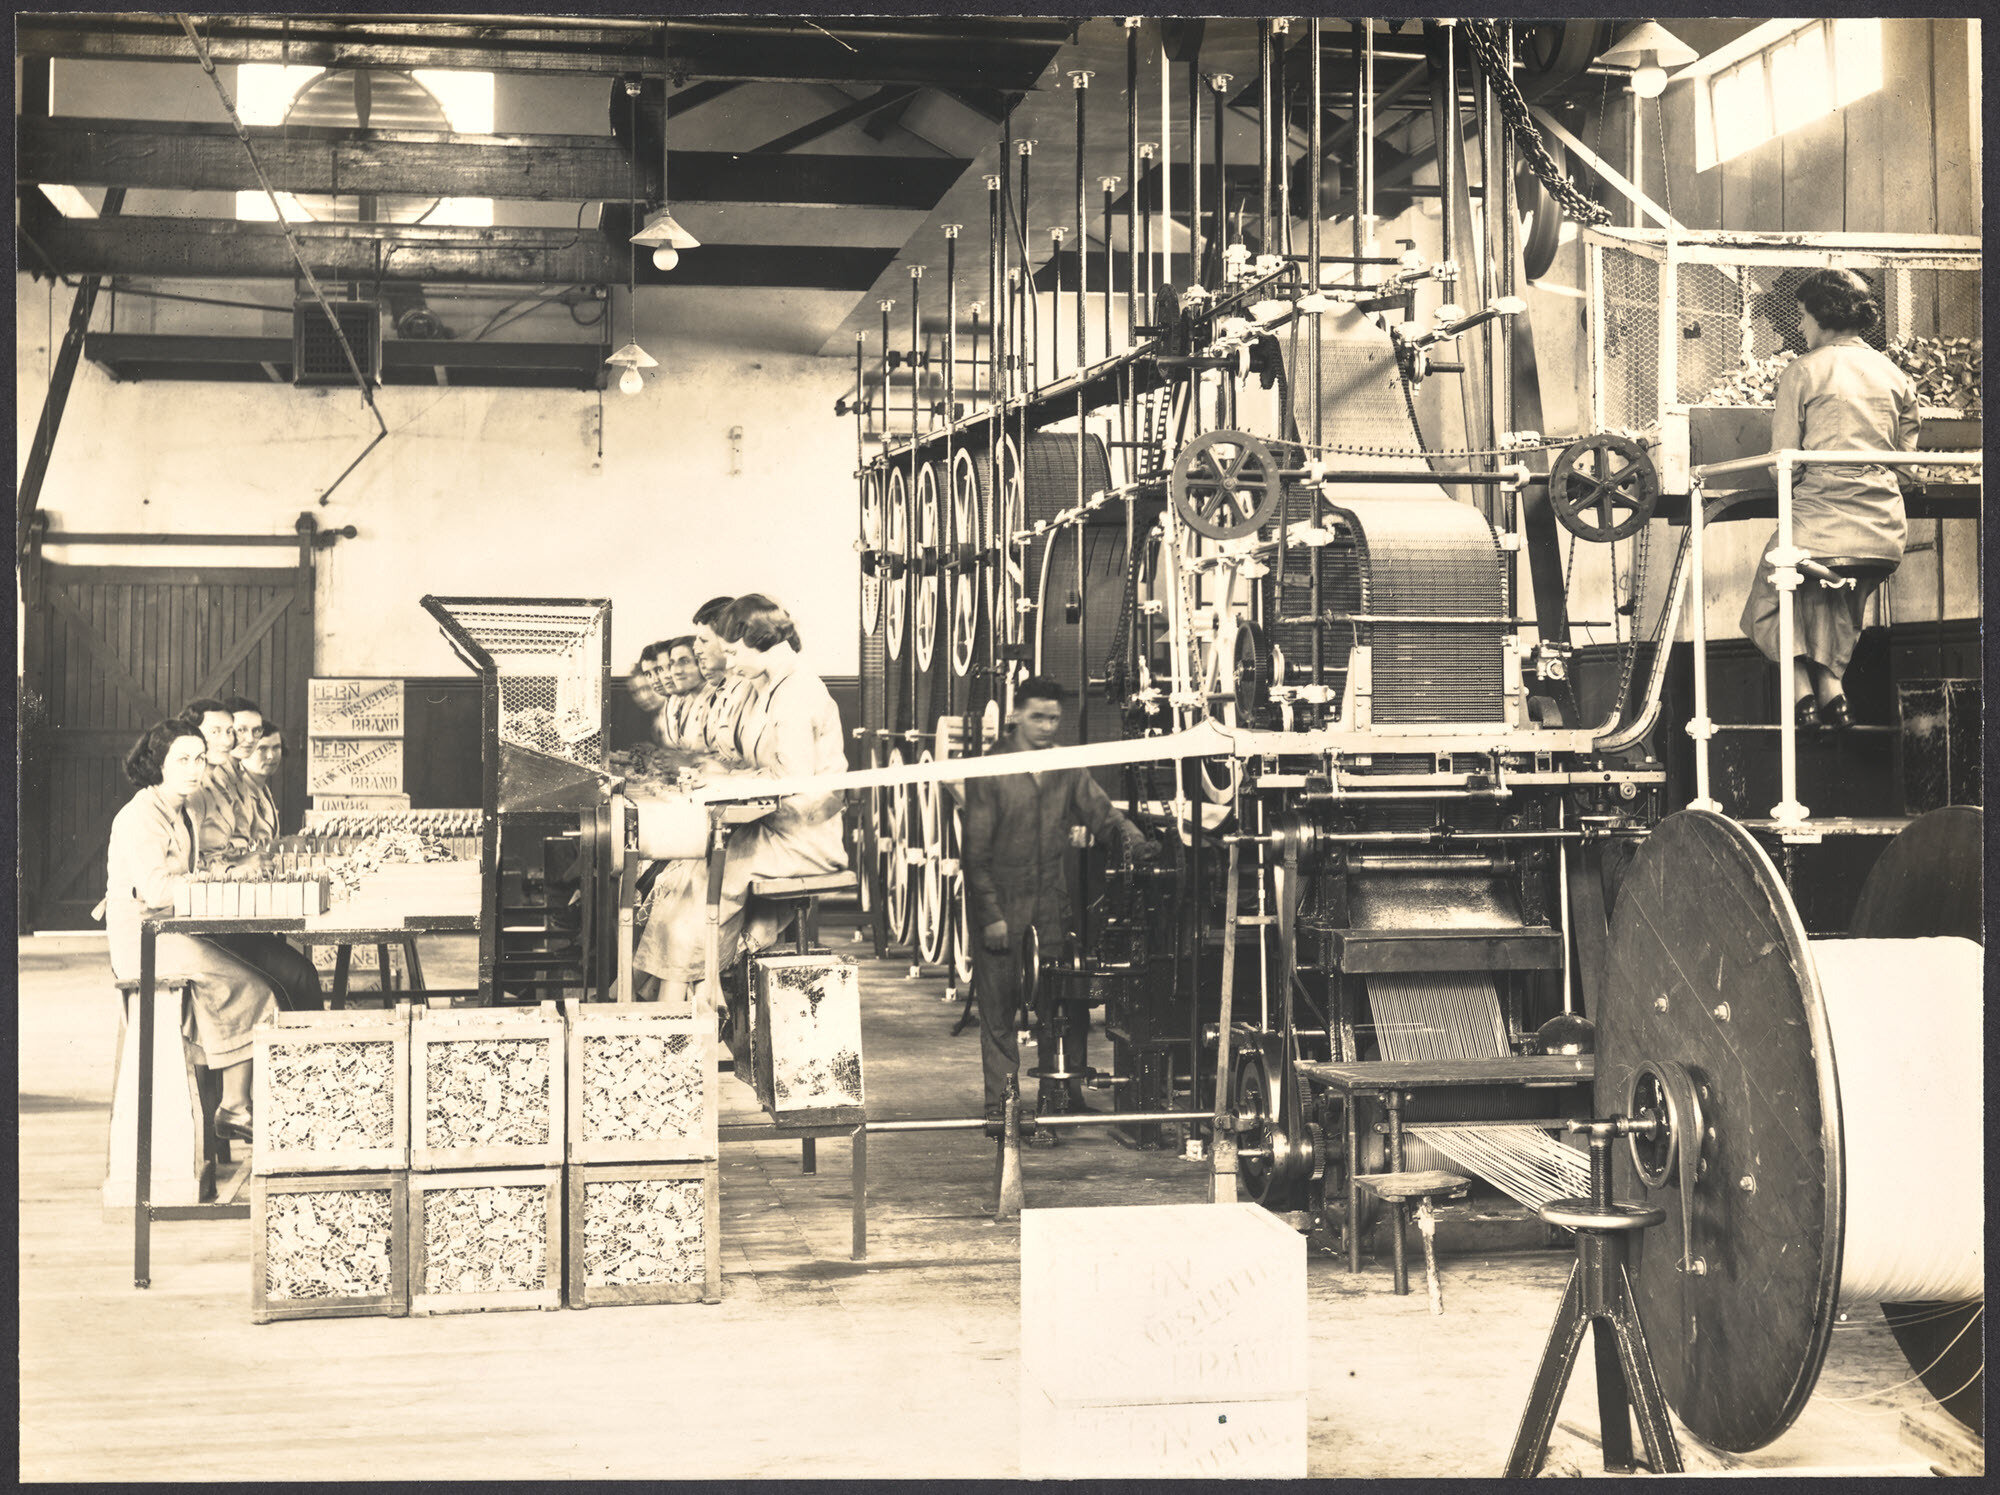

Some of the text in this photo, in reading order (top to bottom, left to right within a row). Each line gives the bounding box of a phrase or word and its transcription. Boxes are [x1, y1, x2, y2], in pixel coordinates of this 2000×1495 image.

[313, 682, 360, 701] FERN
[351, 718, 399, 732] BRAND
[312, 740, 360, 758] FERN
[350, 776, 398, 790] BRAND
